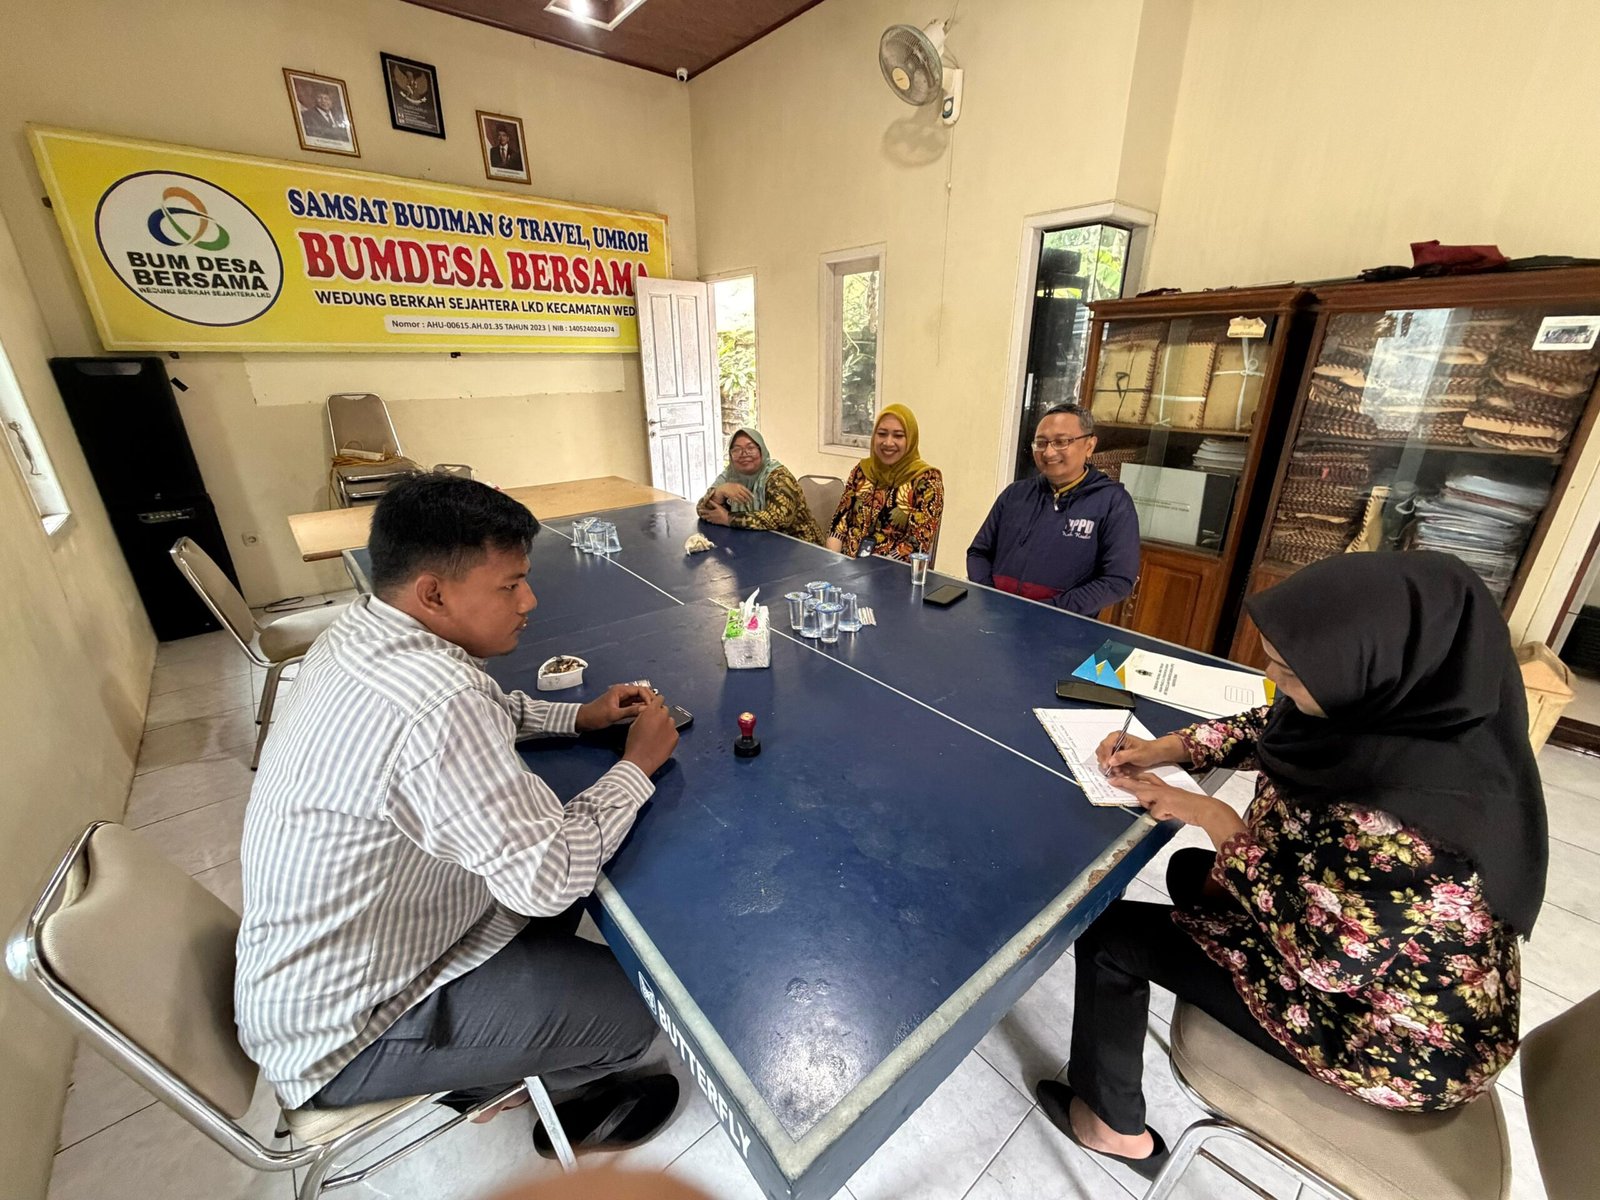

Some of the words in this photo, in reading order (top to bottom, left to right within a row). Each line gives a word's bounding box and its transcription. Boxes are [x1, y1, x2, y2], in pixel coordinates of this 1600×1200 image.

[288, 189, 388, 225] SAMSAT
[392, 202, 495, 236] BUDIMAN
[499, 215, 513, 237] &
[517, 218, 591, 251] TRAVEL,
[593, 227, 649, 252] UMROH
[126, 251, 190, 271] BUM
[196, 255, 266, 275] DESA
[298, 231, 504, 289] BUMDESA
[132, 269, 269, 291] BERSAMA
[256, 291, 272, 299] LKD
[315, 290, 387, 306] WEDUNG
[390, 294, 446, 309] BERKAH
[449, 297, 519, 312] SEJAHTERA
[521, 301, 544, 313] LKD
[546, 302, 611, 316] KECAMATAN
[612, 305, 636, 317] WED
[391, 320, 420, 328] Nomor
[427, 321, 504, 330] AHU-00615.AH.01.35
[504, 323, 529, 331] TAHUN
[569, 325, 615, 333] 1405240241674
[657, 999, 751, 1159] BUTTERFLY
